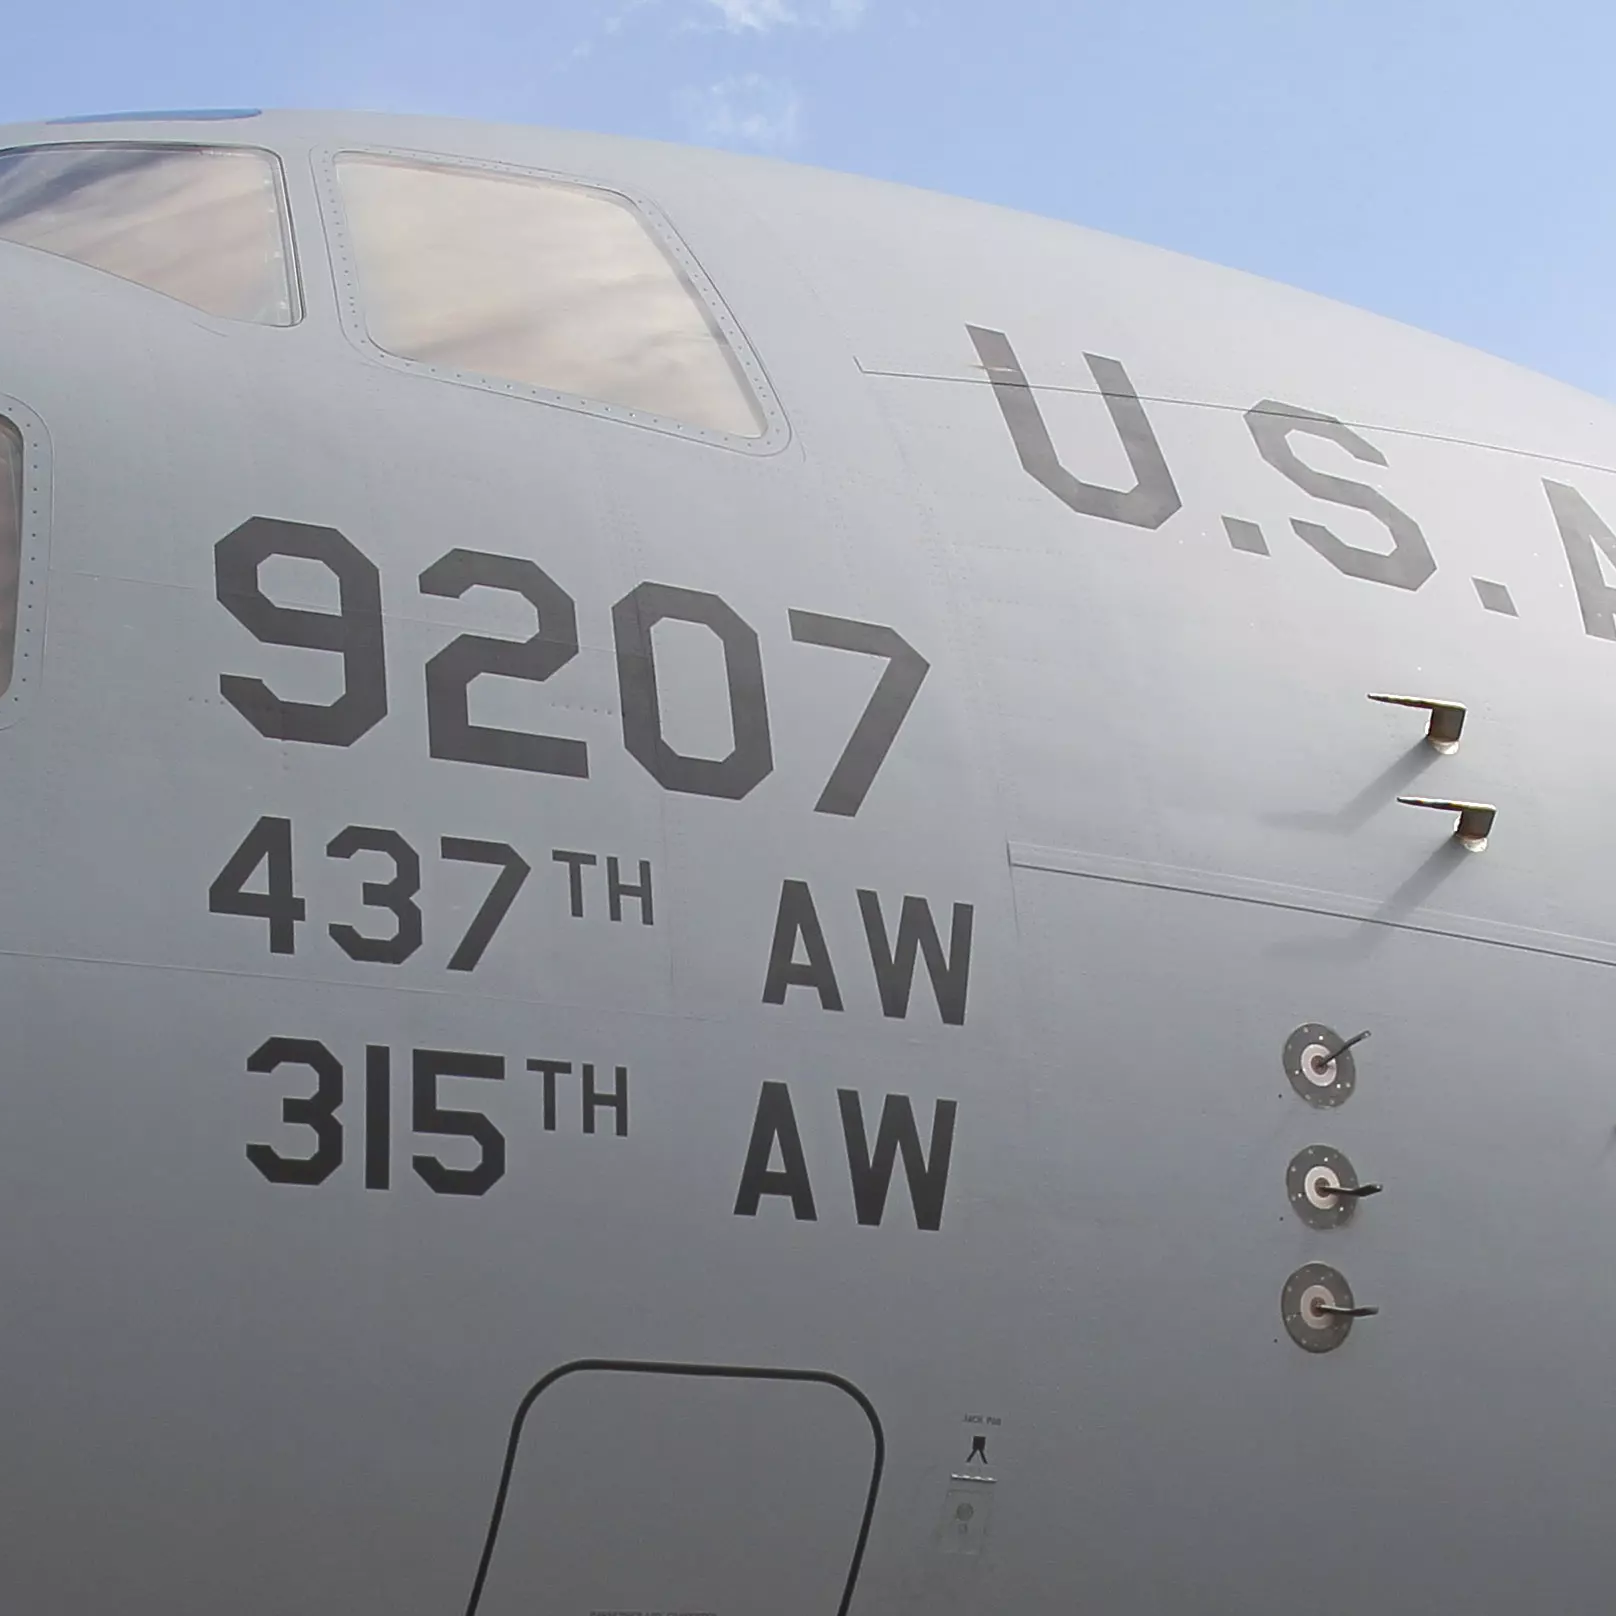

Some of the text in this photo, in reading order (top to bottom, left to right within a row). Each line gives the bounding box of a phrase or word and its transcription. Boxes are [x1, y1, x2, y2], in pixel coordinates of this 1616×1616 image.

[965, 321, 1519, 618] U.S.
[213, 515, 931, 818] 9207
[208, 814, 975, 1027] 437TH AW
[245, 1035, 959, 1232] 315TH AW
